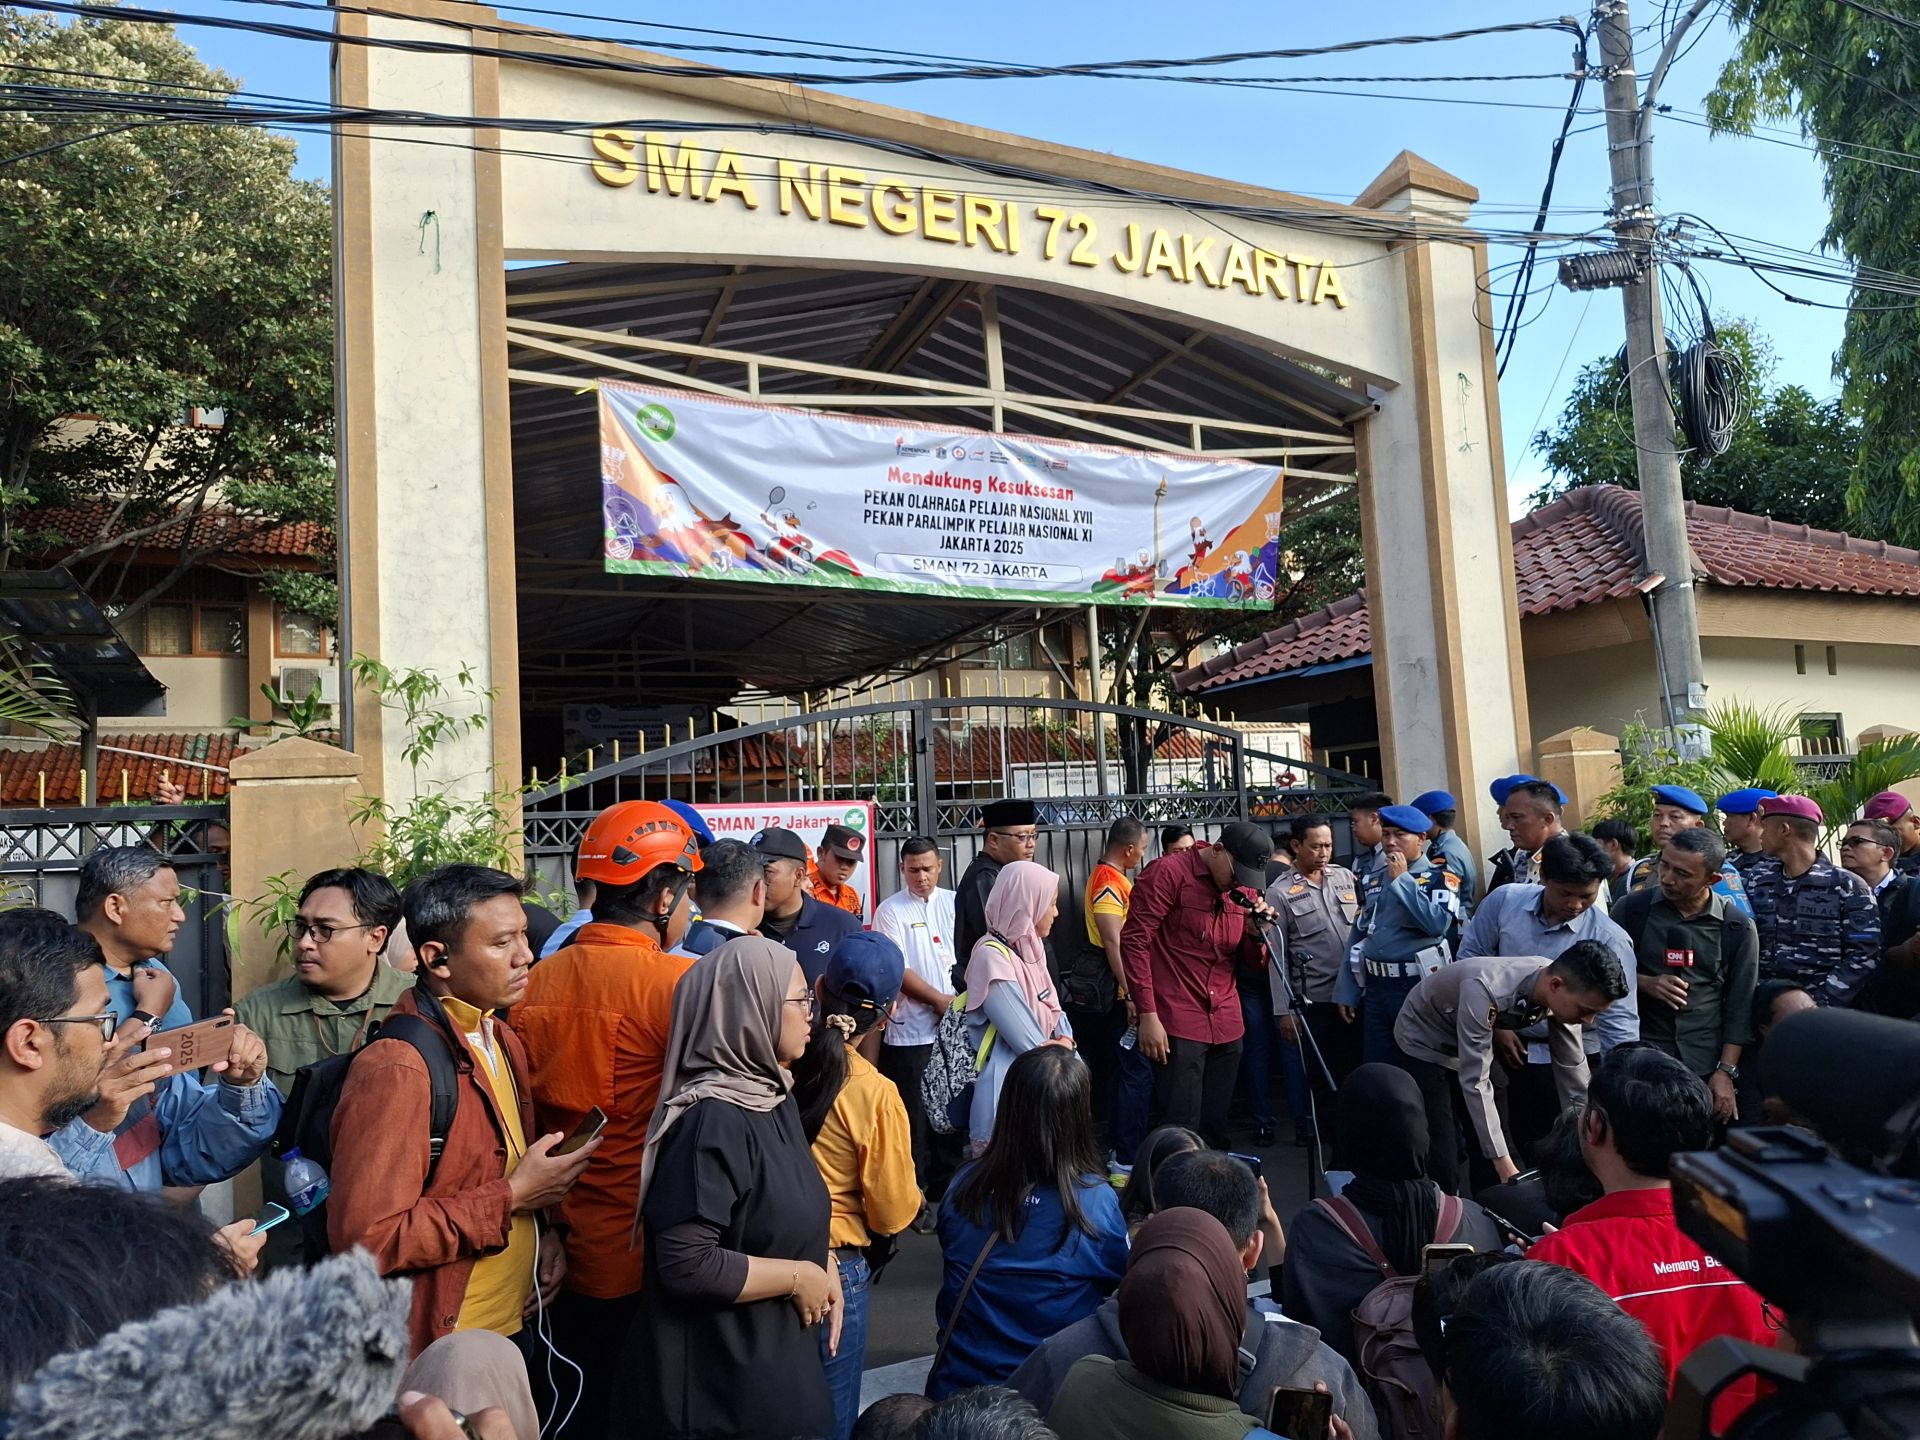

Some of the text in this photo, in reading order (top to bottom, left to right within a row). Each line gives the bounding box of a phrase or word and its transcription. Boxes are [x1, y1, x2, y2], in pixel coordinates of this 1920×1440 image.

[590, 127, 1349, 309] SMA NEGERI 72 JAKARTA
[888, 466, 1074, 501] Mendukung Kesuksesan
[864, 489, 1093, 526] PEKAN OLAHRAGA PELAJAR NASIONAL XVII
[863, 509, 1093, 543] PEKAN PARALIMPIK PELAJAR NASIONAL XI
[940, 535, 1024, 555] JAKARTA 2025
[913, 558, 1048, 579] SMAN 72 JAKARTA
[707, 815, 841, 832] SMAN 72 Jakarta
[1800, 905, 1835, 916] TNI AL
[1667, 952, 1682, 960] CNN
[180, 1031, 194, 1066] 2025
[1653, 1259, 1700, 1275] Memang
